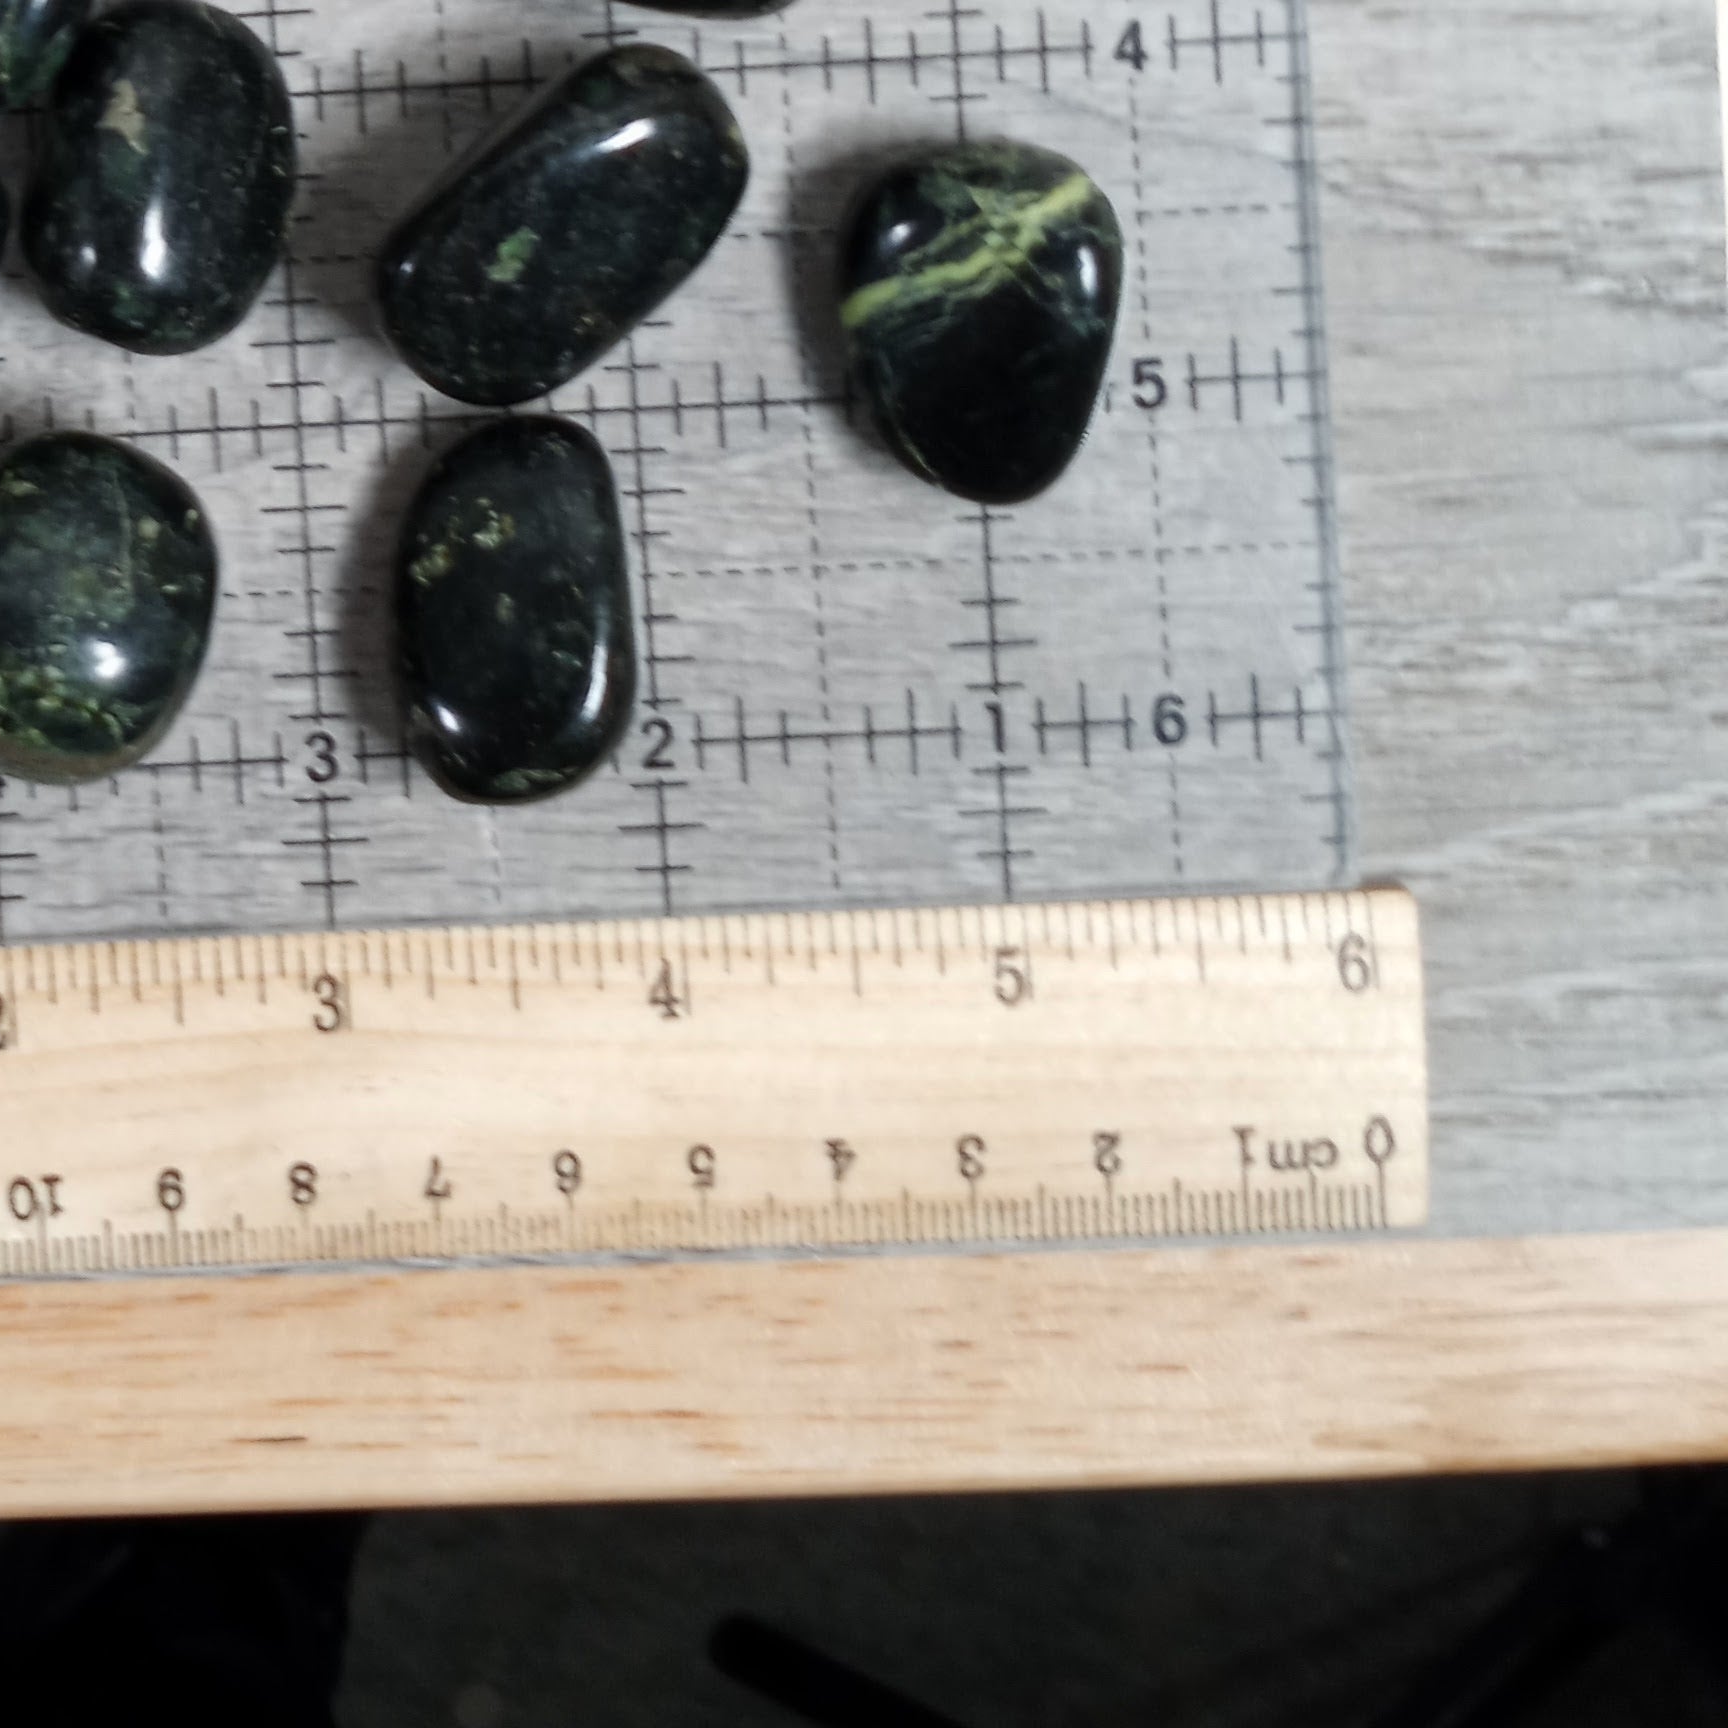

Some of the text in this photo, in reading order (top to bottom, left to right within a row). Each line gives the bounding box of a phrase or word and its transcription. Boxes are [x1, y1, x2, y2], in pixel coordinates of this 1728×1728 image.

[1112, 18, 1148, 72] 4
[1132, 357, 1167, 410] 5
[640, 716, 675, 770] 2
[984, 702, 1006, 755] 1
[1152, 693, 1188, 746] 6
[304, 730, 339, 783] 3
[994, 945, 1027, 1007] 5
[1337, 931, 1371, 993] 6
[312, 972, 344, 1033] 3
[648, 956, 682, 1020] 4
[824, 1137, 857, 1182] 4
[955, 1133, 987, 1181] 3
[1092, 1130, 1123, 1175] 2
[1232, 1125, 1256, 1166] 1
[1267, 1137, 1340, 1170] cm
[1364, 1115, 1397, 1165] 0
[156, 1167, 186, 1213] 9
[288, 1162, 318, 1205] 8
[424, 1155, 452, 1200] 7
[553, 1149, 582, 1196] 6
[687, 1143, 716, 1189] 5
[8, 1174, 64, 1222] 10
